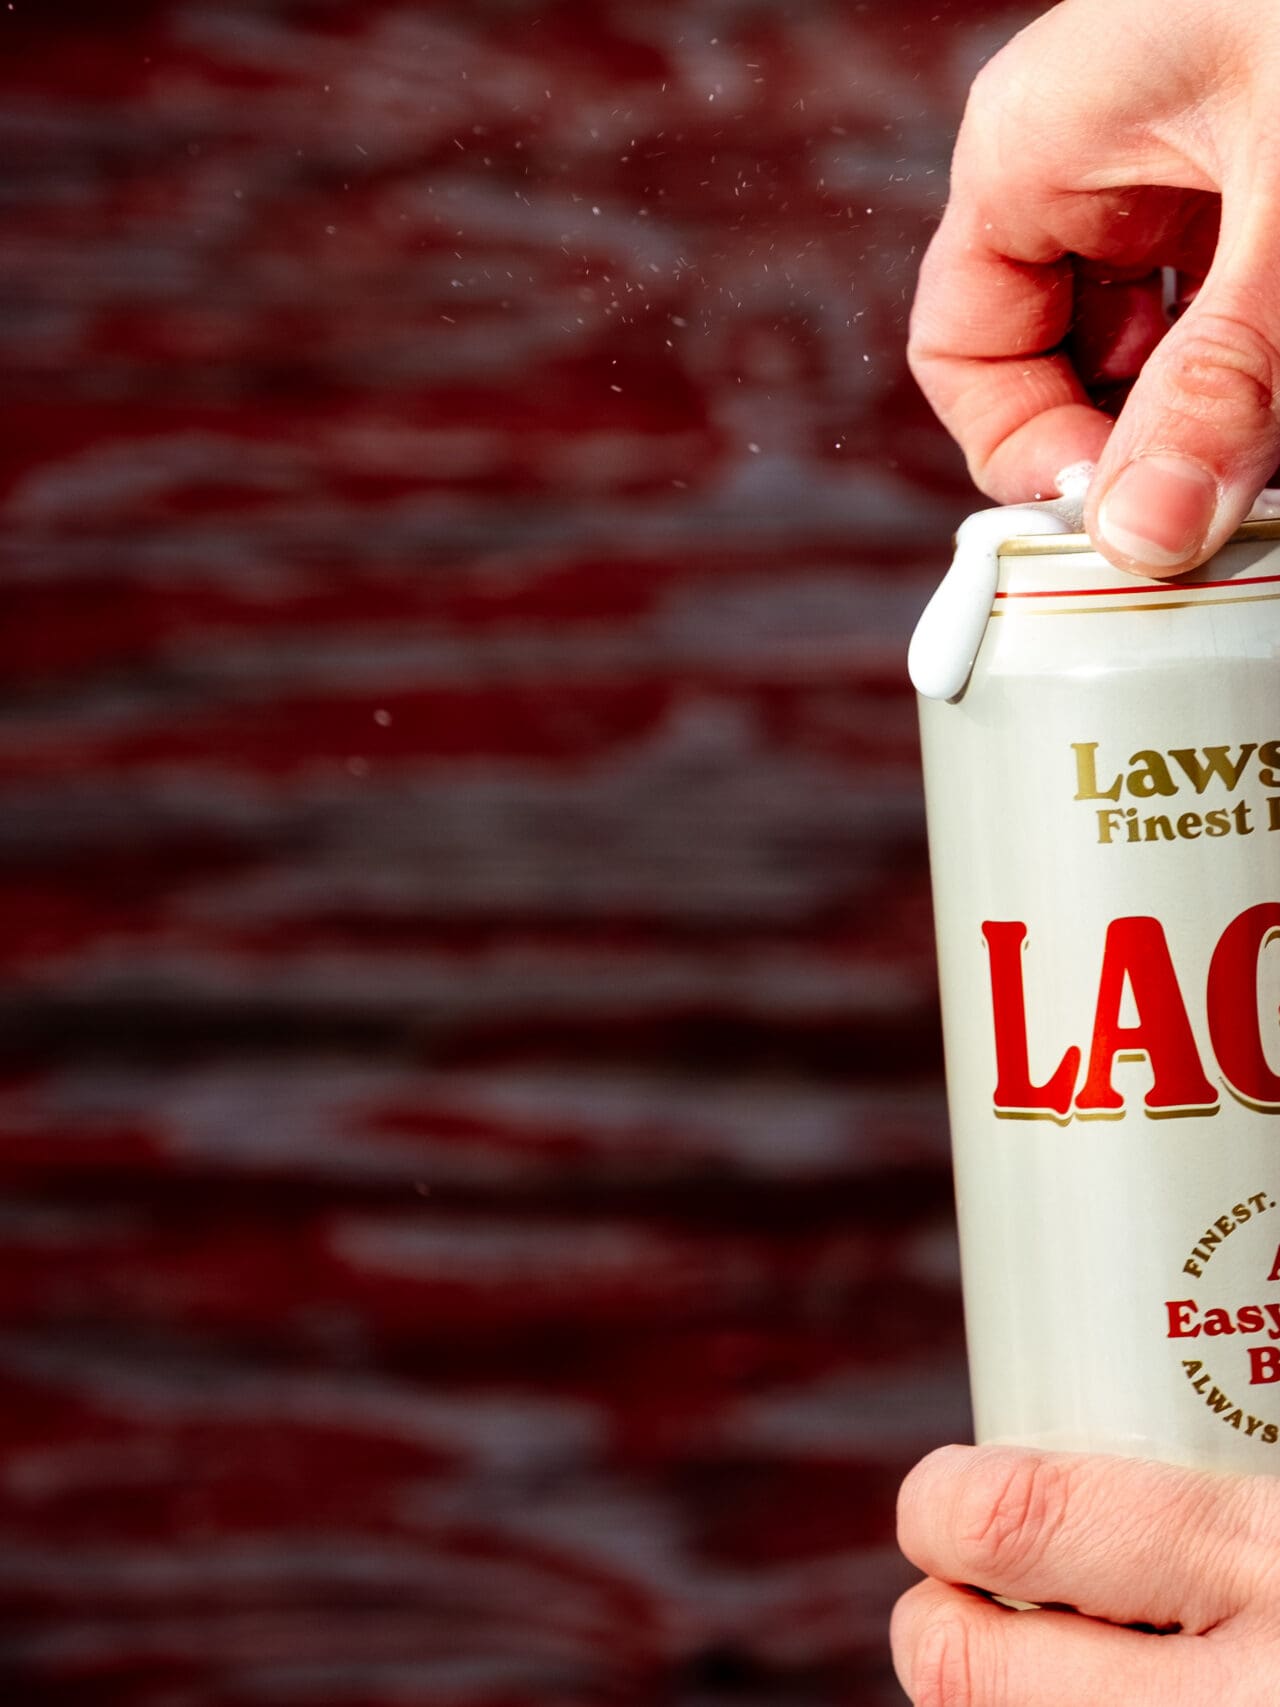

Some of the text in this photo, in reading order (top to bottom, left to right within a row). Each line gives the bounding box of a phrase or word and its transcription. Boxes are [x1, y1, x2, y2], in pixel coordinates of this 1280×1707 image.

[1096, 801, 1254, 844] Finest
[1183, 1191, 1276, 1279] FINEST.
[1182, 1360, 1279, 1444] ALWAYS
